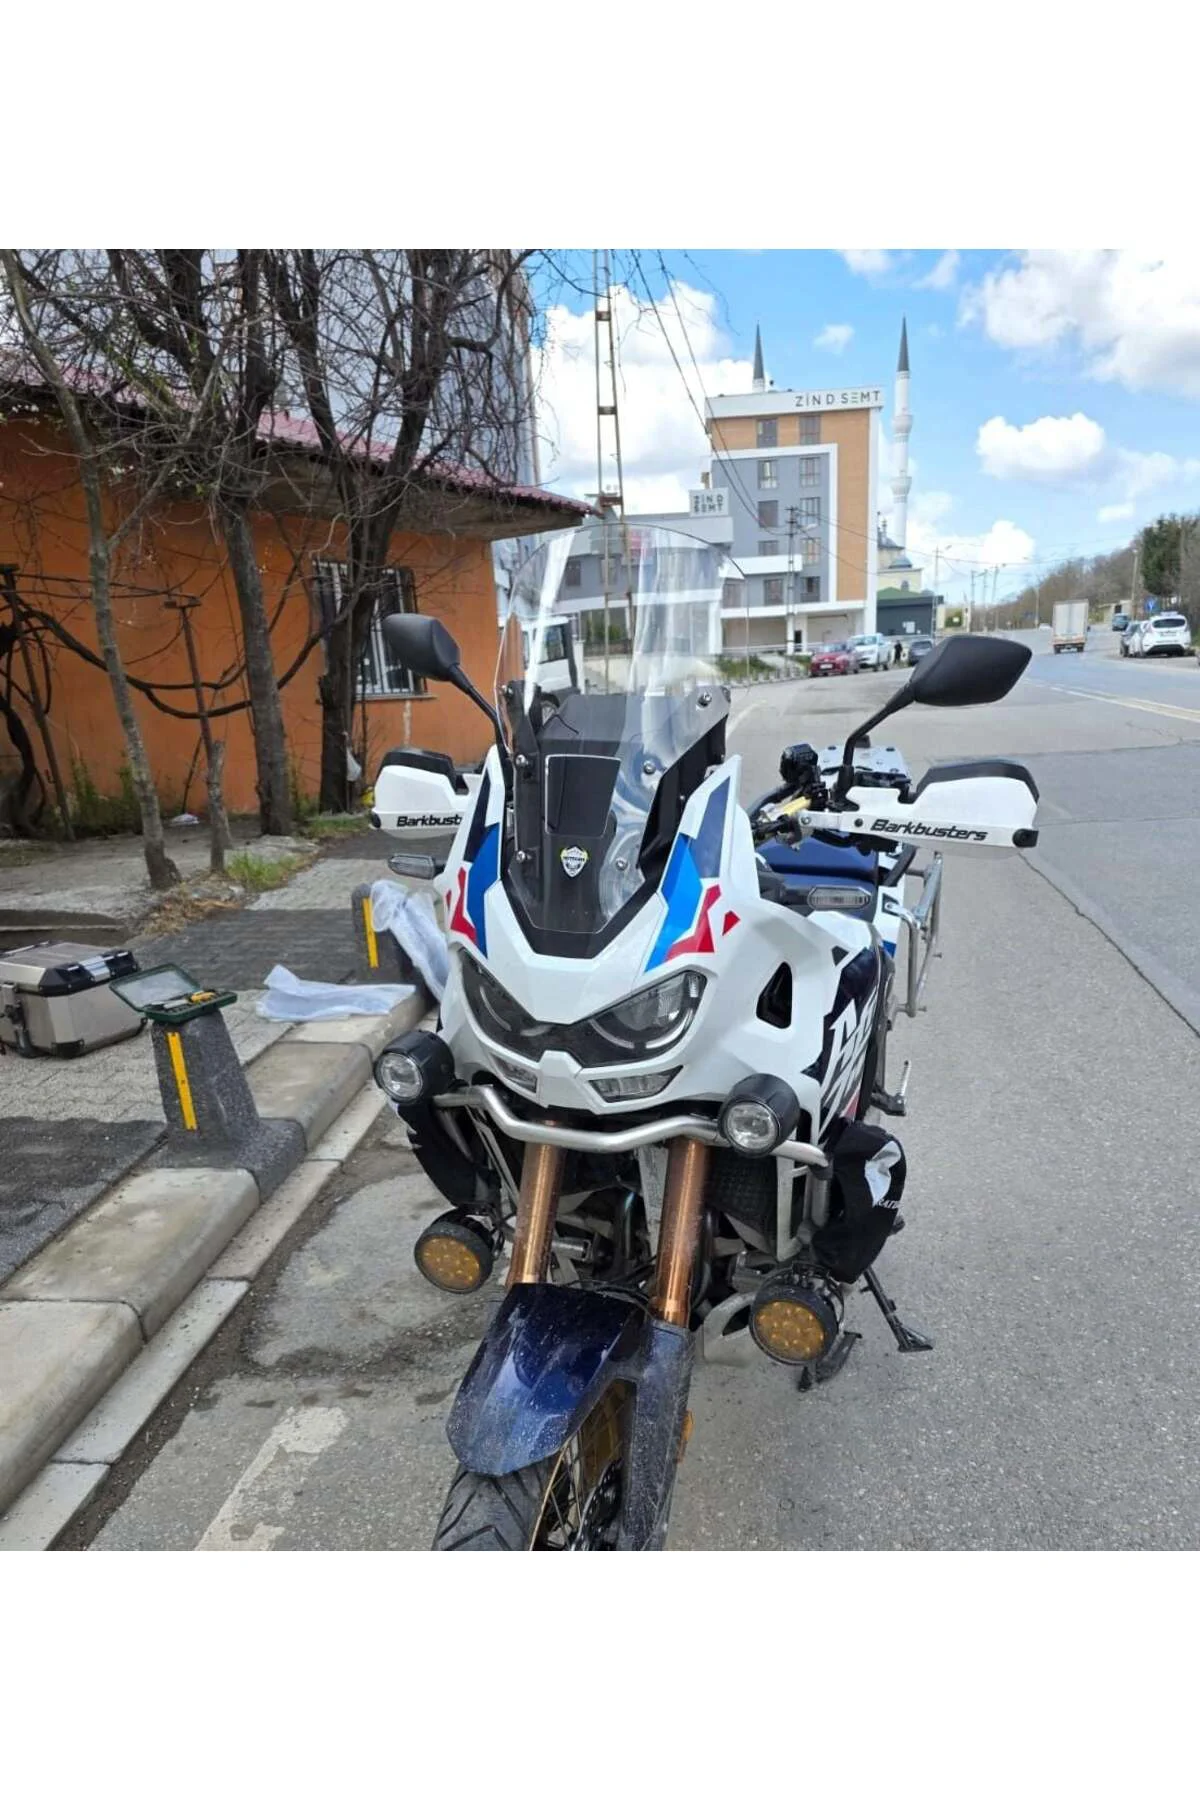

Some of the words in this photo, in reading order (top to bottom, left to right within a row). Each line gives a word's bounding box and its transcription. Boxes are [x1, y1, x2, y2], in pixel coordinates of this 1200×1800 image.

[841, 390, 880, 404] SEMT
[396, 813, 463, 827] Barkbust
[870, 819, 988, 841] Barkbusters
